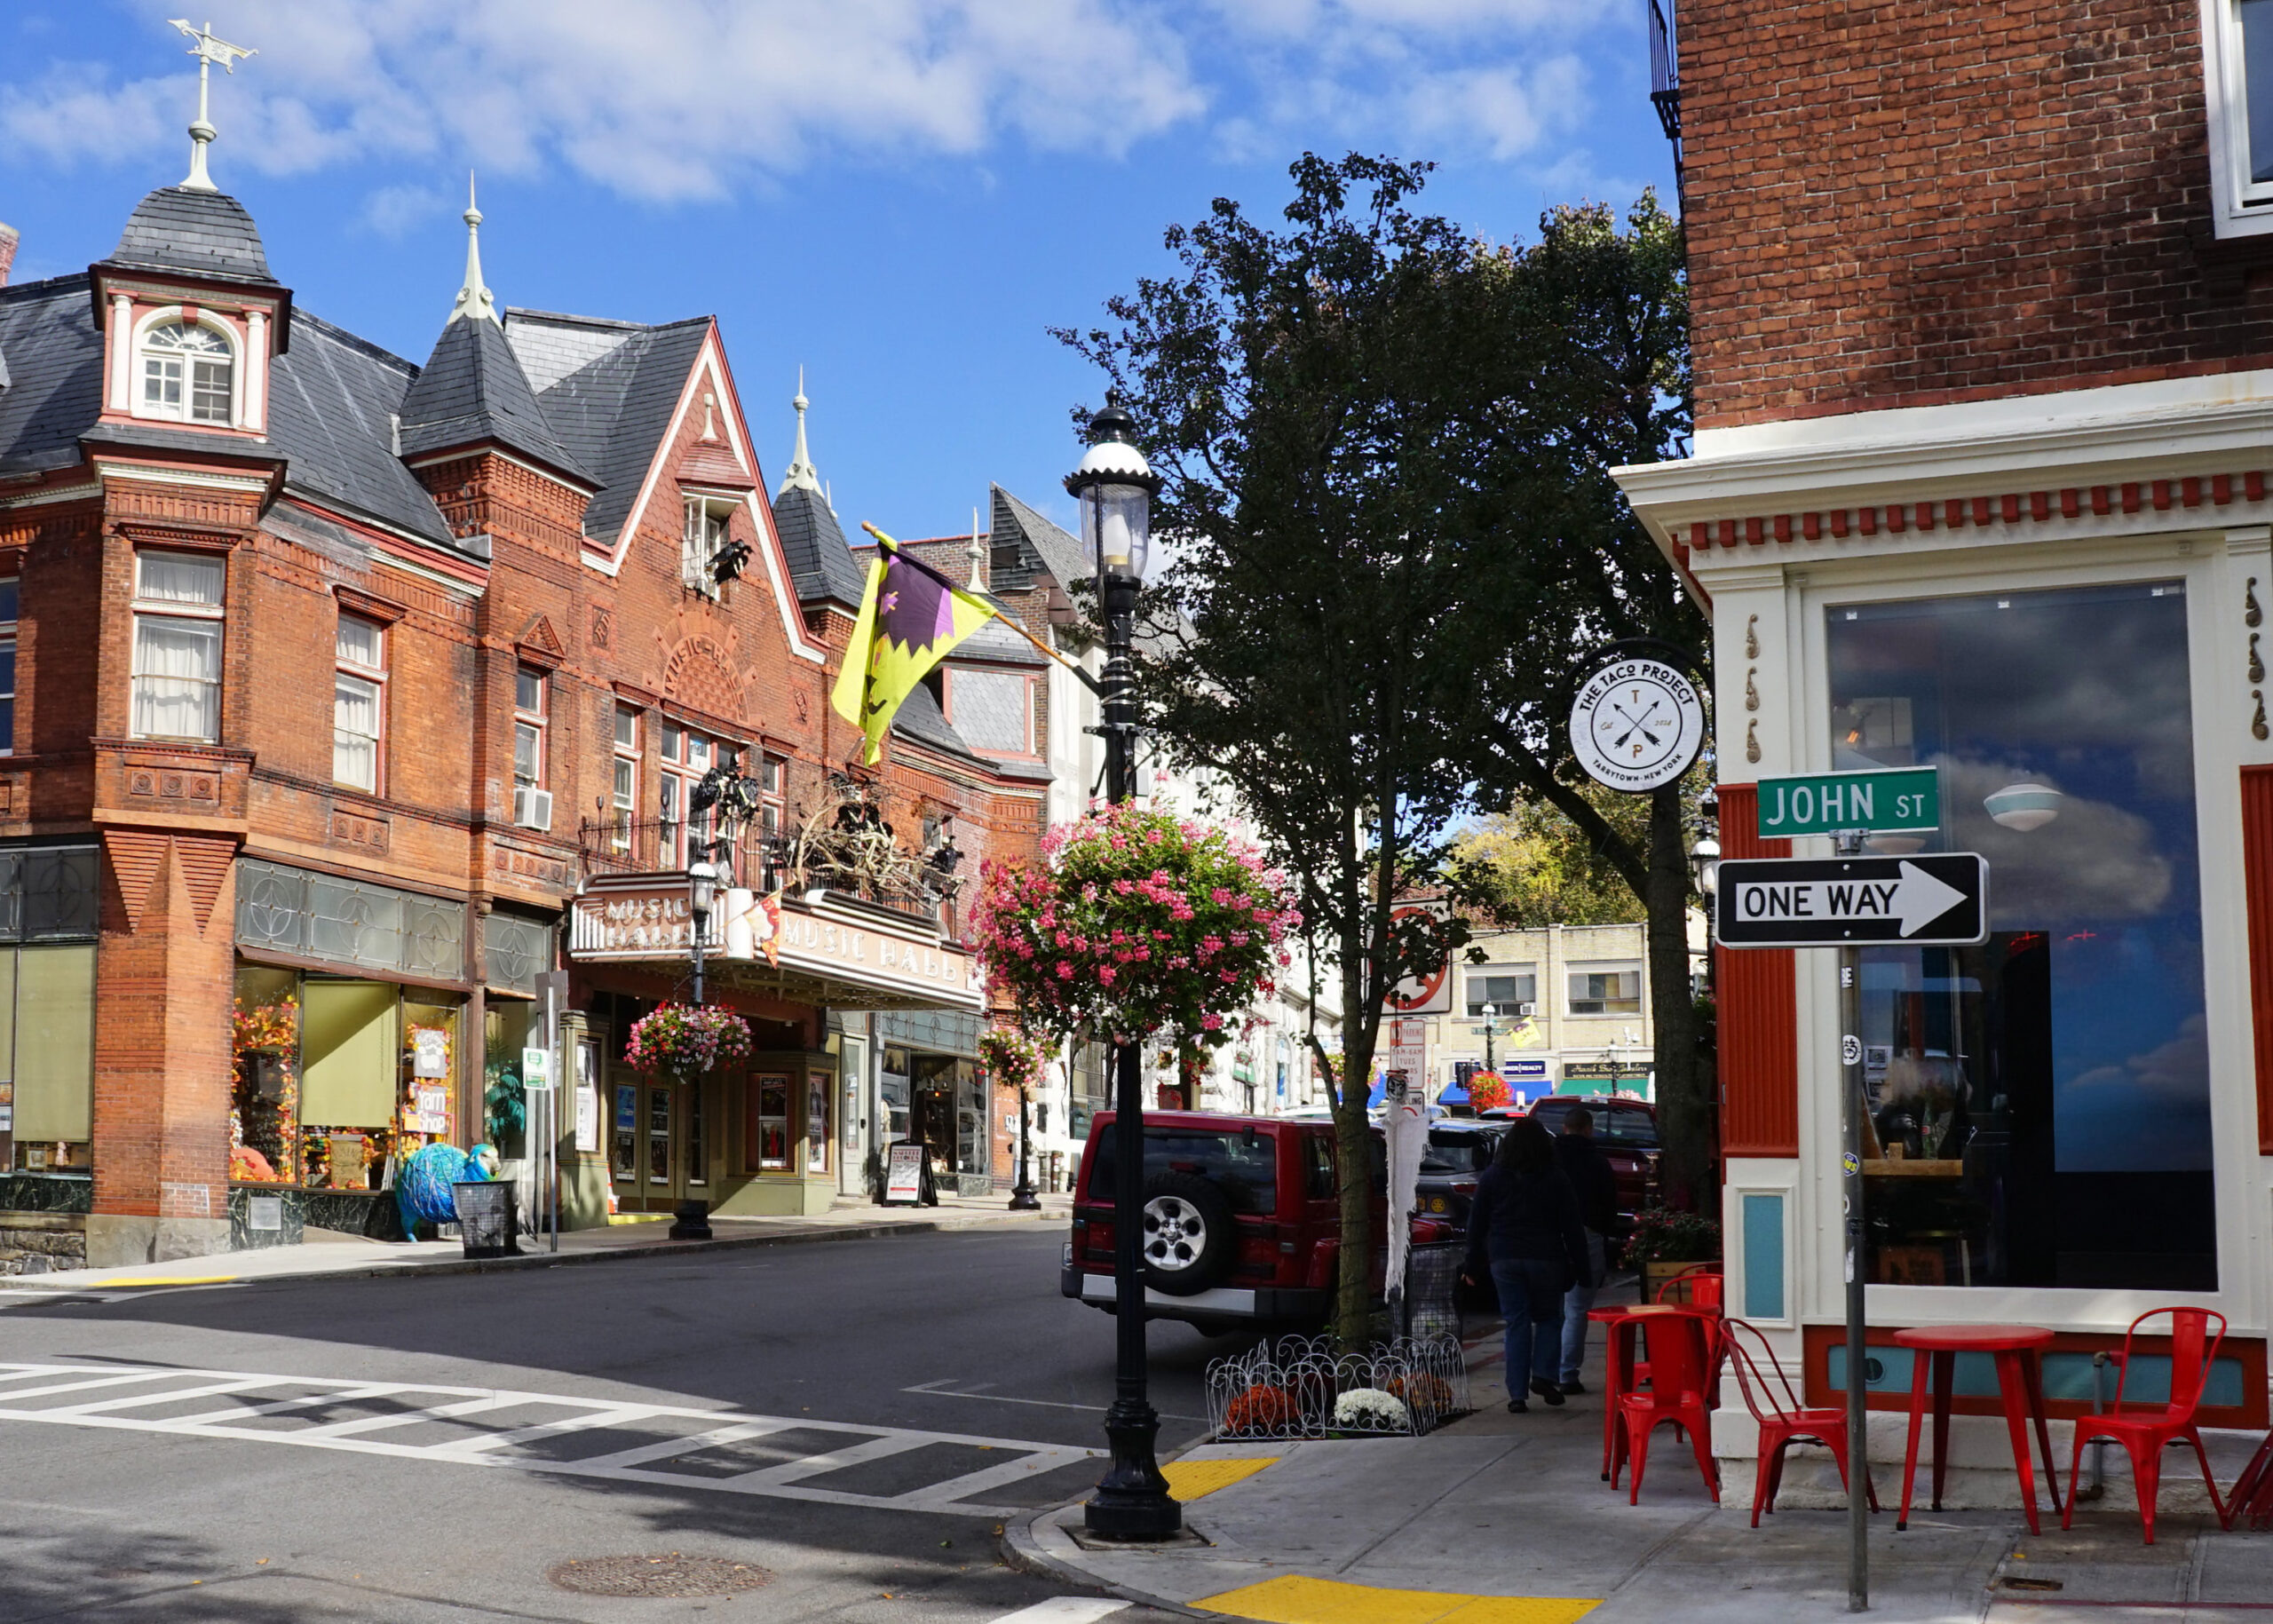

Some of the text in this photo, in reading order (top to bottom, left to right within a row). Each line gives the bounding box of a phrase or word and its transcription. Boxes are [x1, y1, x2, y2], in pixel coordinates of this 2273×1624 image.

[1579, 664, 1694, 711] THE TACO PROJECT
[1631, 689, 1640, 704] T
[1633, 744, 1643, 758] P
[1592, 753, 1683, 781] TARRYTOWN NEW YORK
[1766, 783, 1926, 825] JOHN ST
[606, 898, 690, 920] MUSIC
[1744, 883, 1899, 918] ONE WAY
[784, 915, 958, 982] MUSIC HALL
[1402, 1028, 1422, 1037] PARKING
[417, 1091, 446, 1112] Yarn
[418, 1111, 445, 1132] Shop
